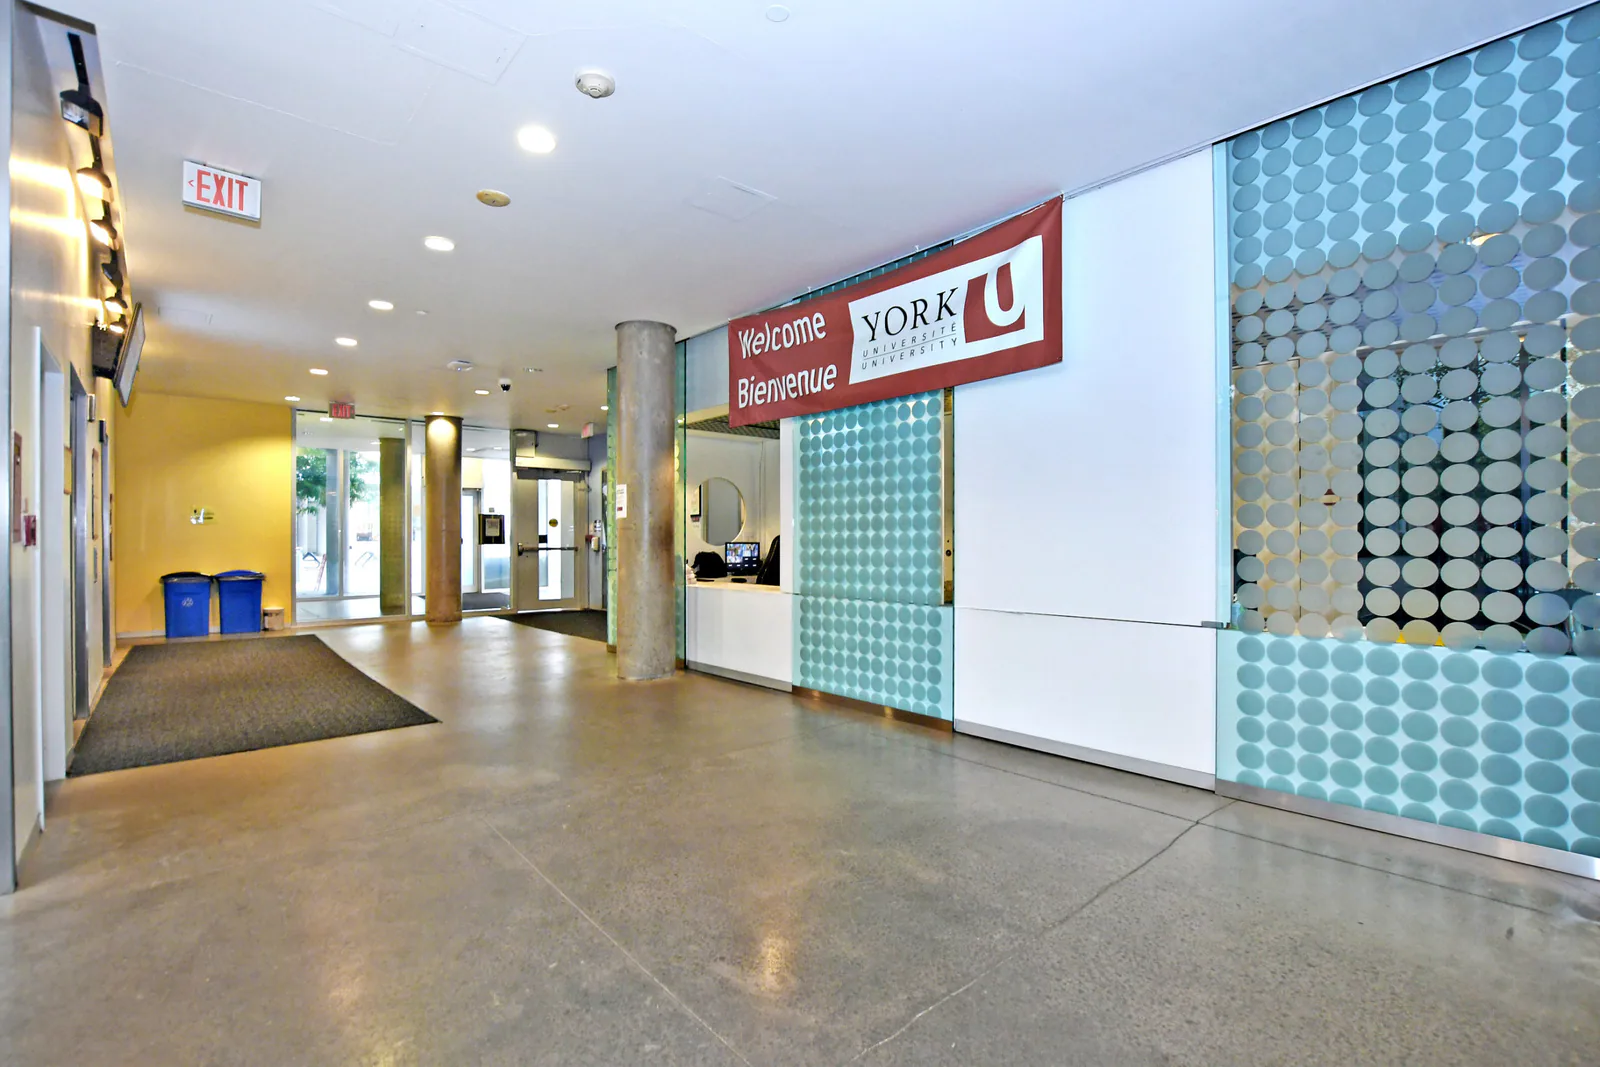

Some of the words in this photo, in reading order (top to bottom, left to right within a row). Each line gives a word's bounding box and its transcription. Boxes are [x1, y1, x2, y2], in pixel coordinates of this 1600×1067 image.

[196, 169, 249, 212] EXIT
[738, 312, 827, 360] Welcome
[861, 286, 959, 343] YORK
[861, 337, 958, 370] UNIVERSITY
[862, 321, 957, 358] UNIVERSITÉ
[738, 363, 838, 409] Bienvenue
[331, 403, 352, 418] EXIT
